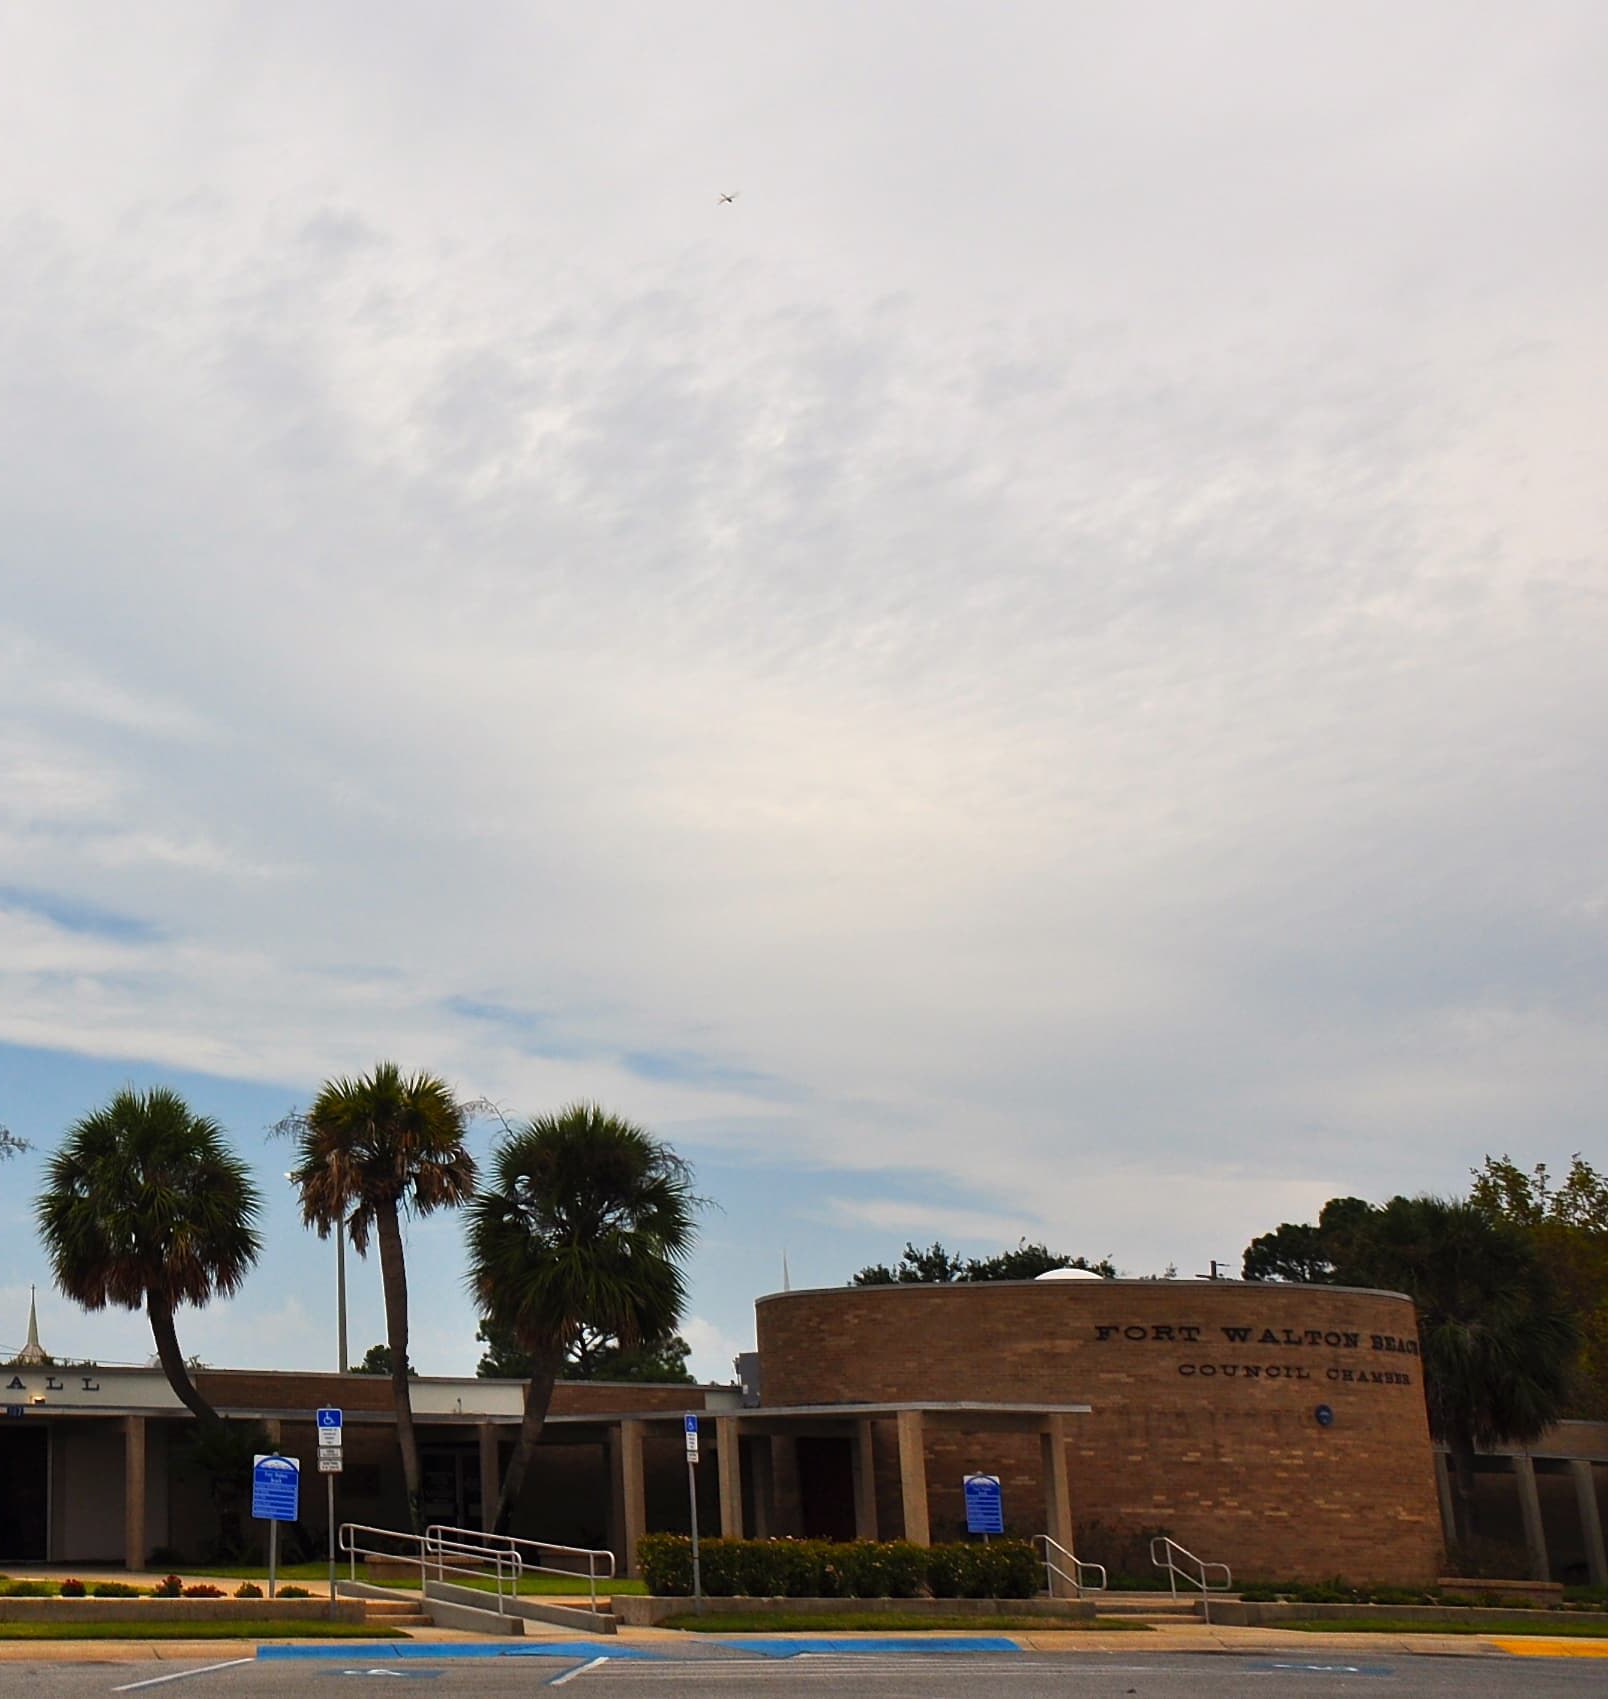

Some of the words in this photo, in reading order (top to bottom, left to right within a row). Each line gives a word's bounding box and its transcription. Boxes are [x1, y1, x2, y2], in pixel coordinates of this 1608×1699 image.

[1094, 1325, 1201, 1342] FORT
[1220, 1326, 1360, 1348] WALTON
[1178, 1363, 1310, 1380] COUNCIL
[1326, 1368, 1411, 1386] CHAMBER
